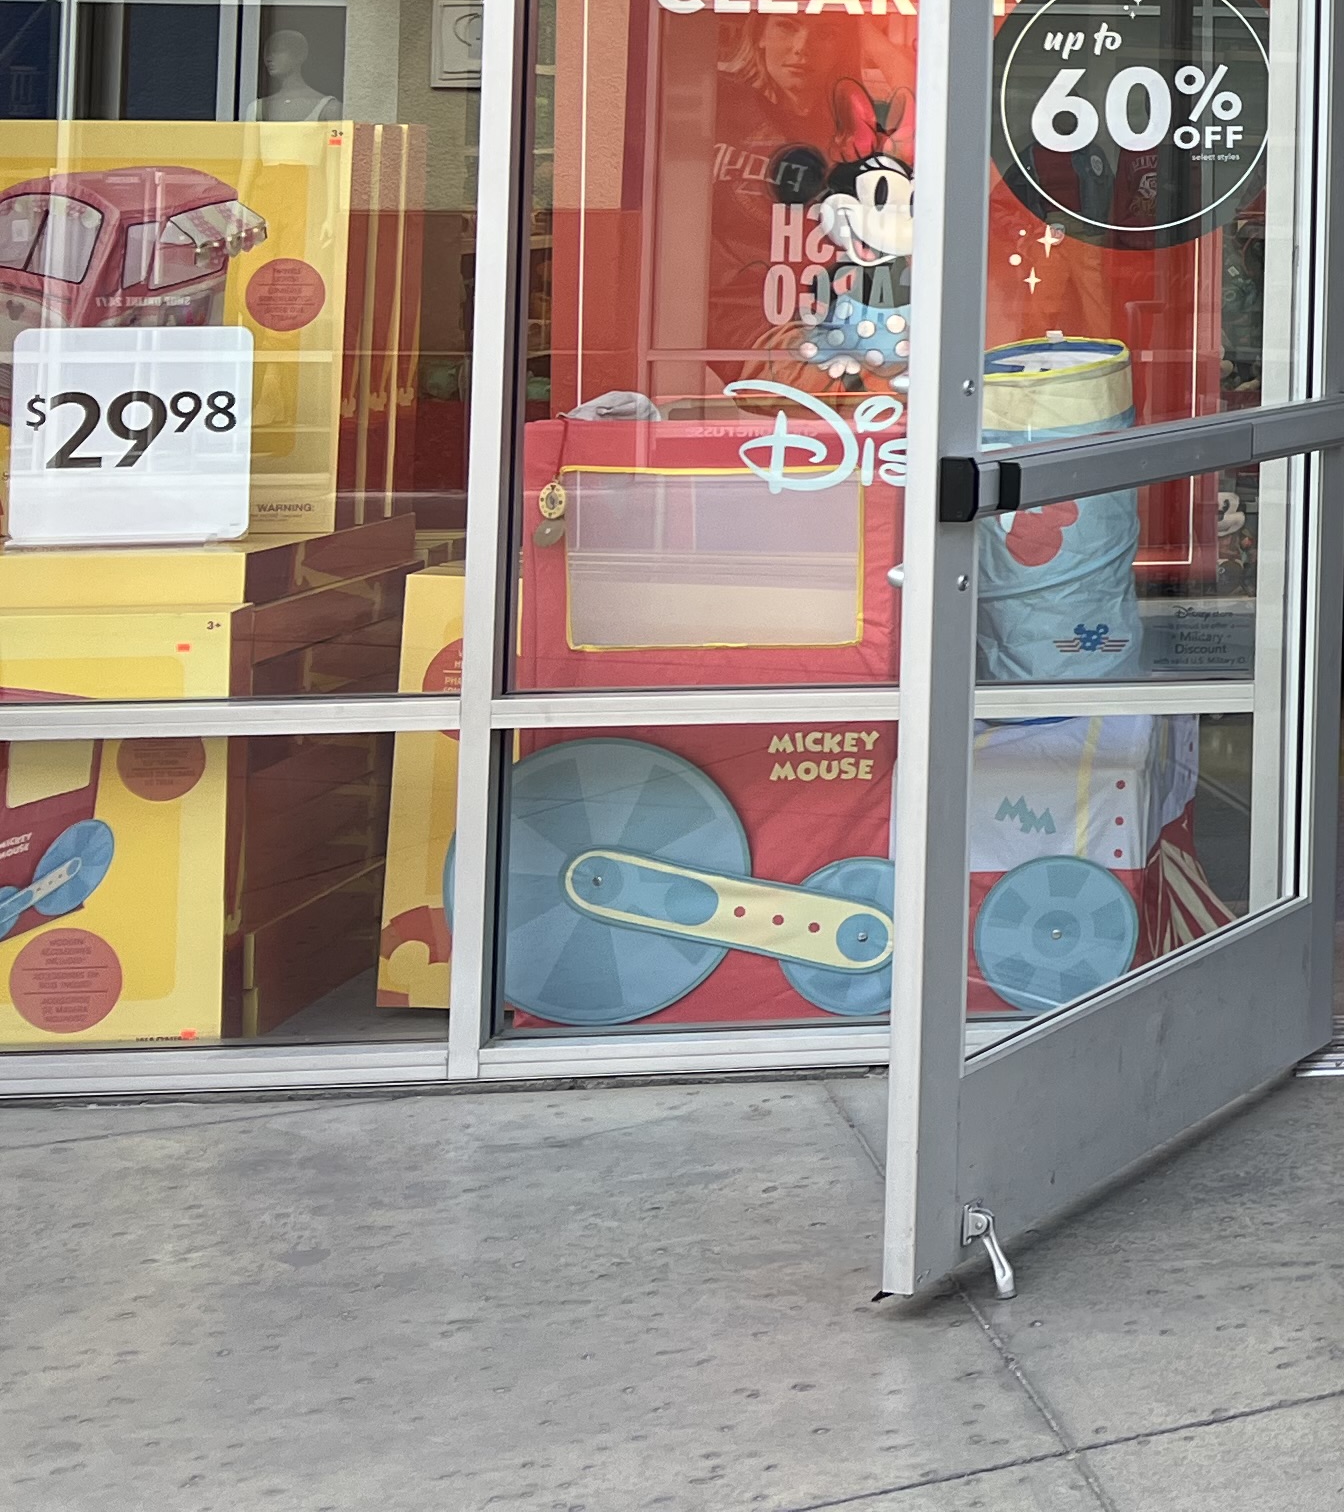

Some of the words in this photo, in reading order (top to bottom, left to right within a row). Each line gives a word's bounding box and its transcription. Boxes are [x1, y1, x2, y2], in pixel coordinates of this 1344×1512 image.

[1044, 33, 1085, 60] up
[1093, 22, 1123, 56] to
[1030, 64, 1243, 153] 60%
[1173, 125, 1244, 150] OFF
[1218, 154, 1241, 162] styles
[1174, 643, 1228, 654] Discount
[1180, 632, 1225, 645] Military
[768, 729, 880, 755] MICKEY
[769, 757, 875, 782] MOUSE
